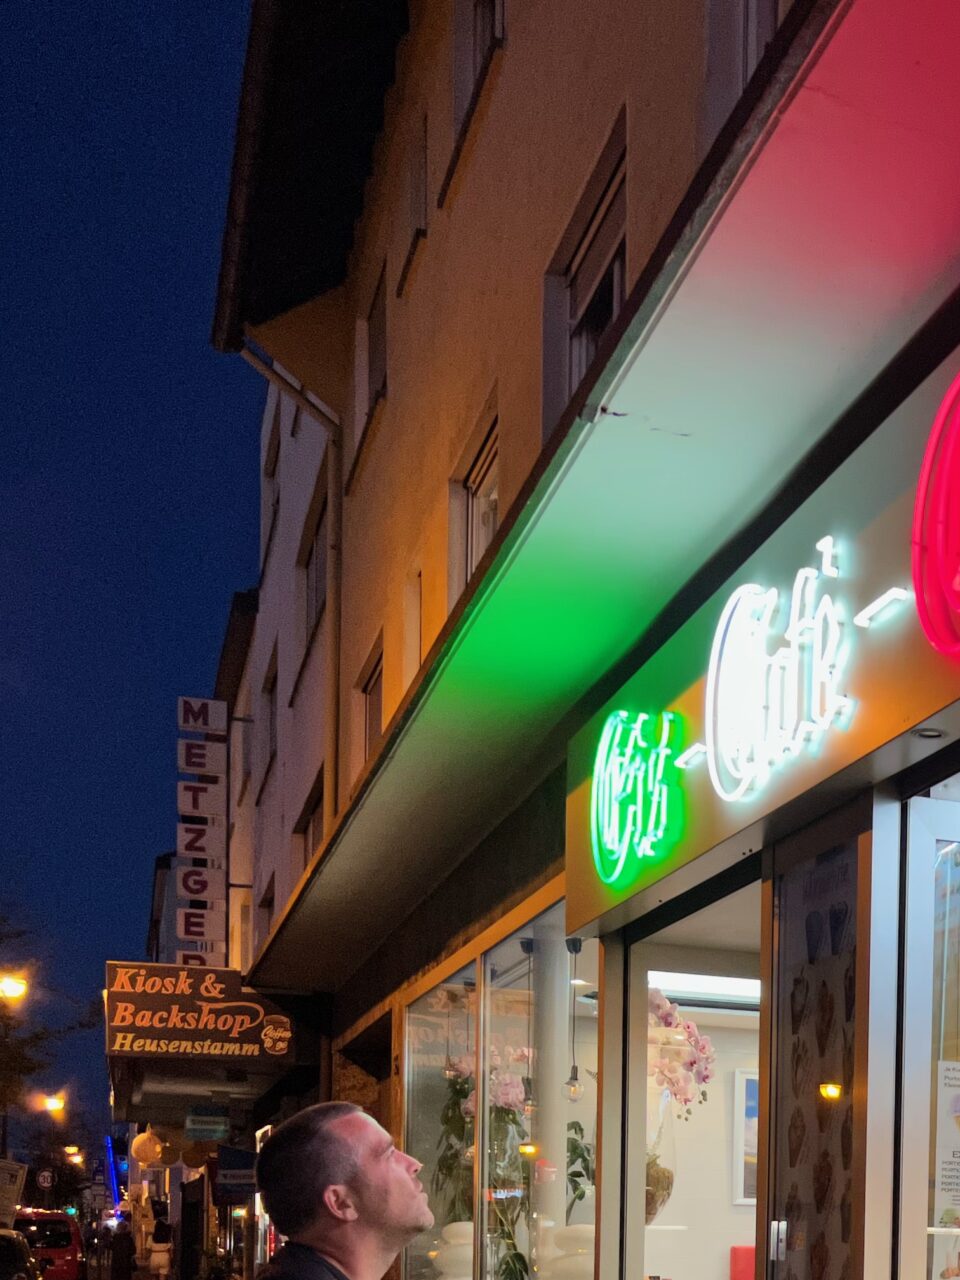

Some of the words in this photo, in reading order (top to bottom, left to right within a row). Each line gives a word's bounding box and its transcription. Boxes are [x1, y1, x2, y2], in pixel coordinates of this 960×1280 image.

[705, 536, 852, 802] Café
[110, 968, 193, 996] Kiosk
[200, 973, 226, 998] &
[110, 1001, 256, 1038] Backshop
[112, 1032, 260, 1057] Heusenstamm
[41, 1173, 53, 1185] 30
